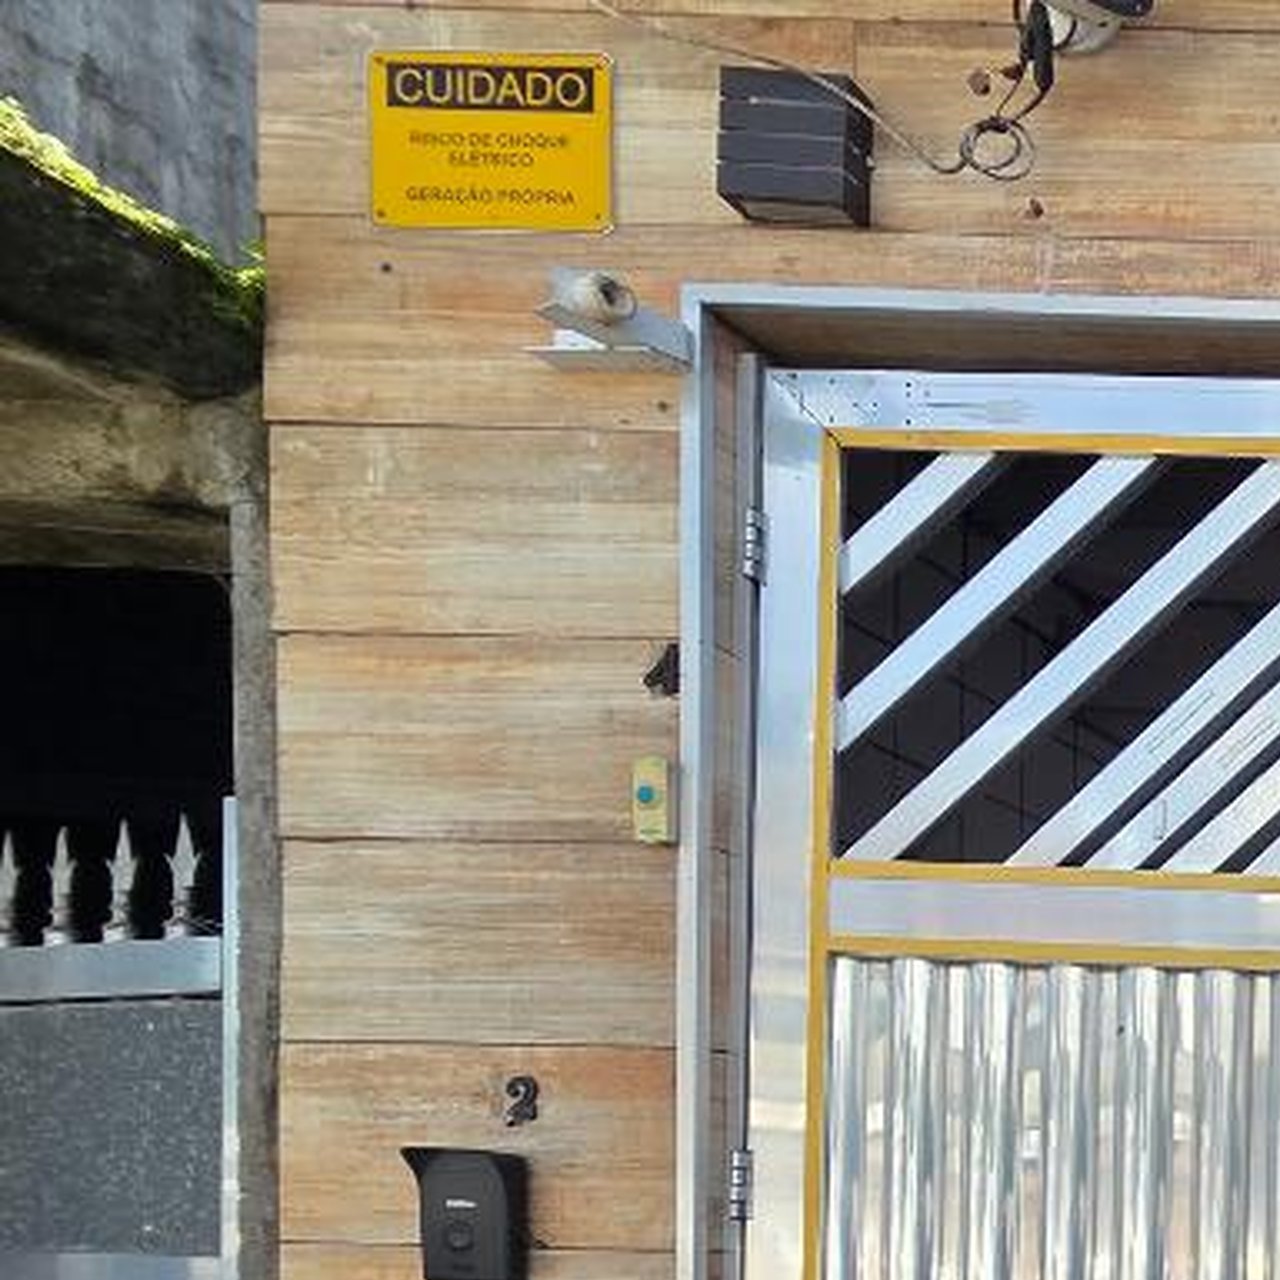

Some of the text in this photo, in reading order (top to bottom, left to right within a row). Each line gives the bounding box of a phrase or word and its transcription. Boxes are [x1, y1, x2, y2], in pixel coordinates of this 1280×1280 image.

[394, 68, 588, 108] CUIDADO
[468, 131, 493, 148] DE
[495, 132, 569, 149] CHOQUE
[504, 1074, 539, 1128] 2
